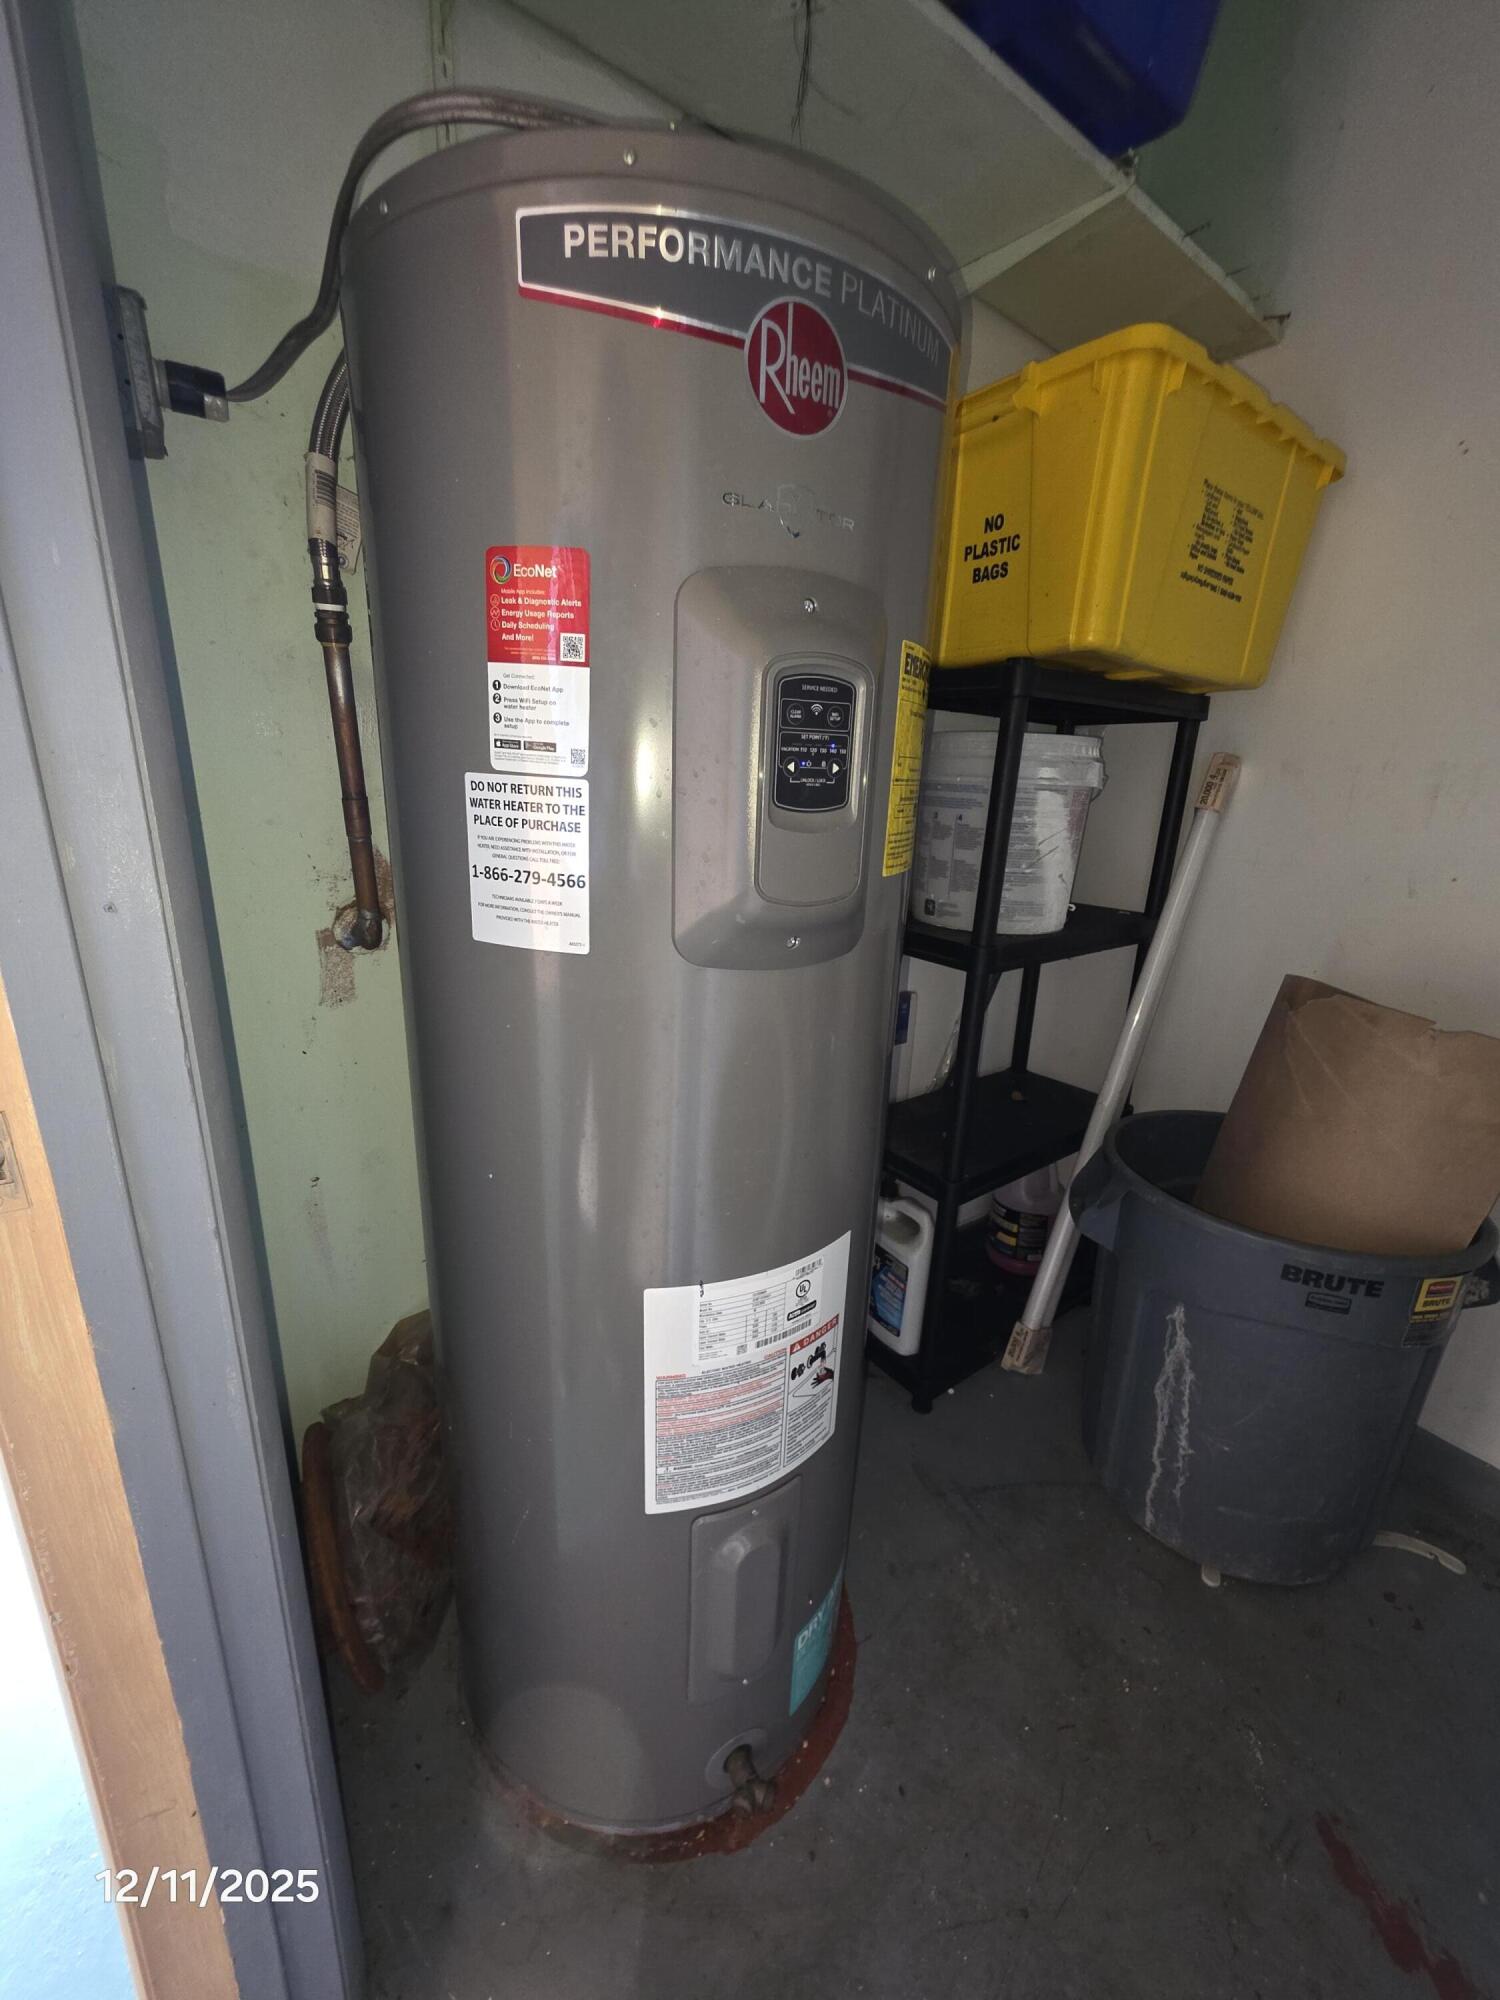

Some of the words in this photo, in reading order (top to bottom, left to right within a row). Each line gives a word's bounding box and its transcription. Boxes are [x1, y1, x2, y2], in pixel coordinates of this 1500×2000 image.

[563, 223, 832, 297] PERFORMANCE
[840, 272, 940, 366] PLATINUM
[759, 301, 840, 415] Rheem
[983, 513, 1005, 534] NO
[964, 533, 1021, 562] PLASTIC
[513, 563, 557, 578] EcoNet
[971, 561, 1009, 585] BAGS
[501, 597, 517, 605] Leak
[524, 598, 559, 607] Diagnostic
[561, 598, 582, 607] Alerts
[501, 608, 524, 618] Energy
[524, 610, 545, 619] Usage
[547, 610, 574, 619] Reports
[501, 621, 517, 630] Daily
[518, 621, 554, 632] Scheduling
[501, 633, 514, 641] And
[515, 633, 533, 641] More!
[503, 683, 529, 691] Download
[802, 684, 819, 692] SERVICE
[819, 685, 838, 693] NEEDED
[532, 698, 548, 706] Setup
[471, 780, 485, 792] DO
[487, 781, 508, 793] NOT
[510, 783, 554, 797] RETURN
[556, 786, 582, 799] THIS
[469, 797, 501, 810] WATER
[503, 800, 544, 813] HEATER
[545, 803, 560, 815] TO
[562, 804, 586, 816] THE
[473, 814, 503, 827] PLACE
[505, 817, 519, 829] OF
[521, 818, 581, 833] PURCHASE
[472, 864, 586, 888] 1-866-279-4566
[1280, 1263, 1385, 1298] BRUTE
[1422, 1298, 1451, 1308] BRUTE
[803, 1317, 838, 1345] DANGER
